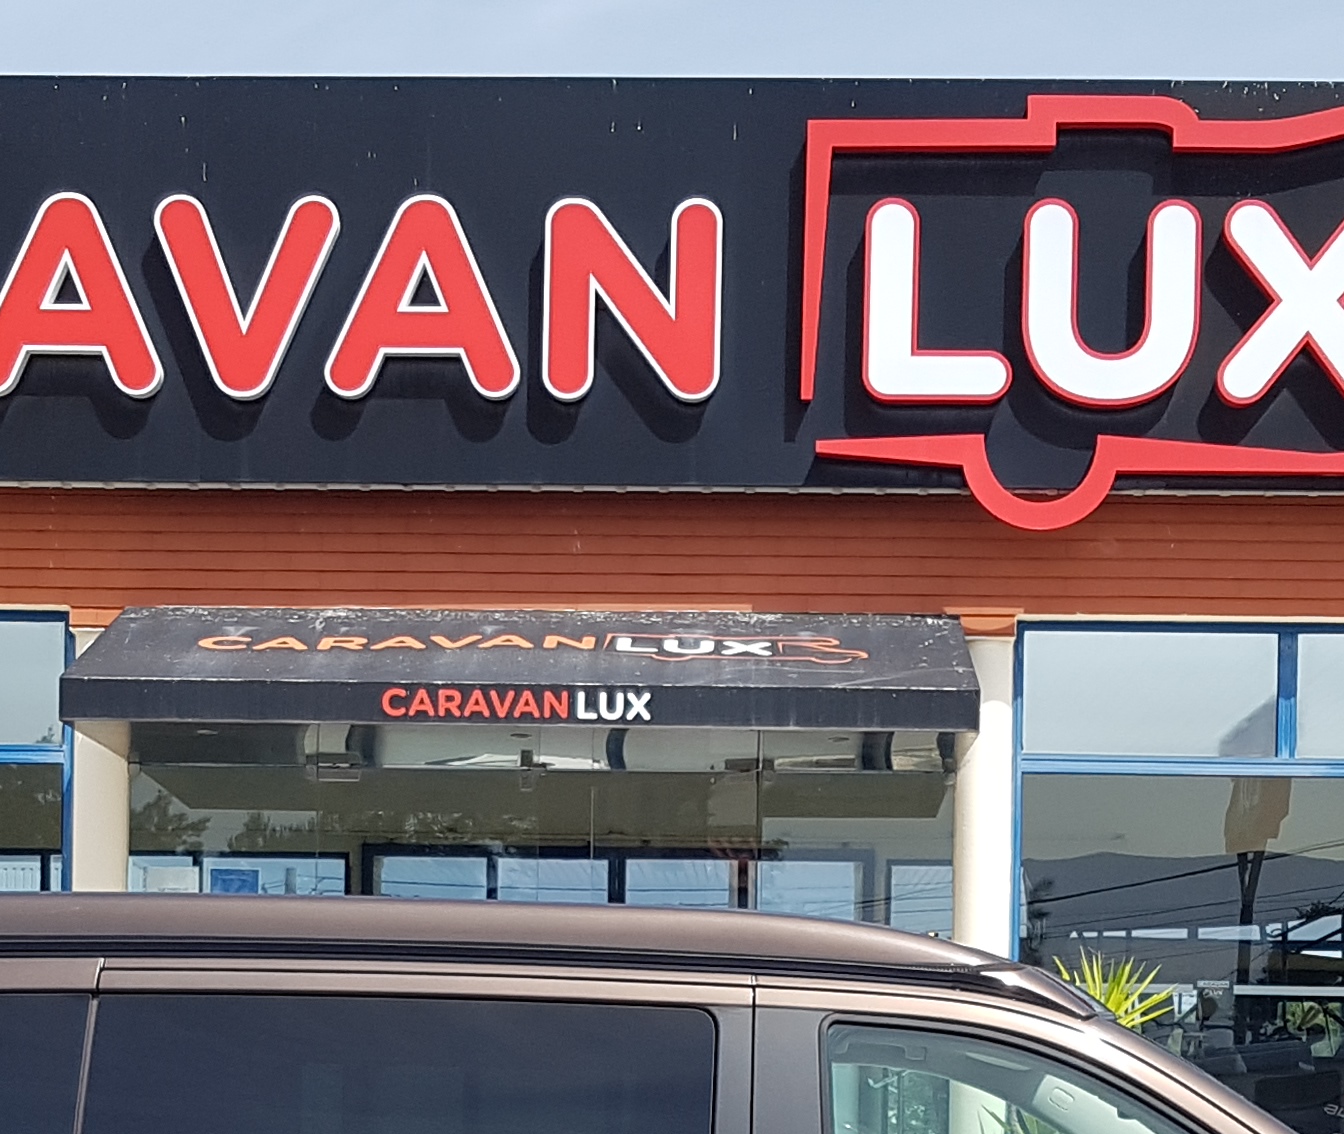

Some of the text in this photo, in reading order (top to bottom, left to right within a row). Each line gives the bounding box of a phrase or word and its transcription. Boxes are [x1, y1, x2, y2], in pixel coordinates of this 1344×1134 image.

[197, 635, 773, 656] CARAVAN LUX
[381, 688, 652, 722] CARAVAN LUX
